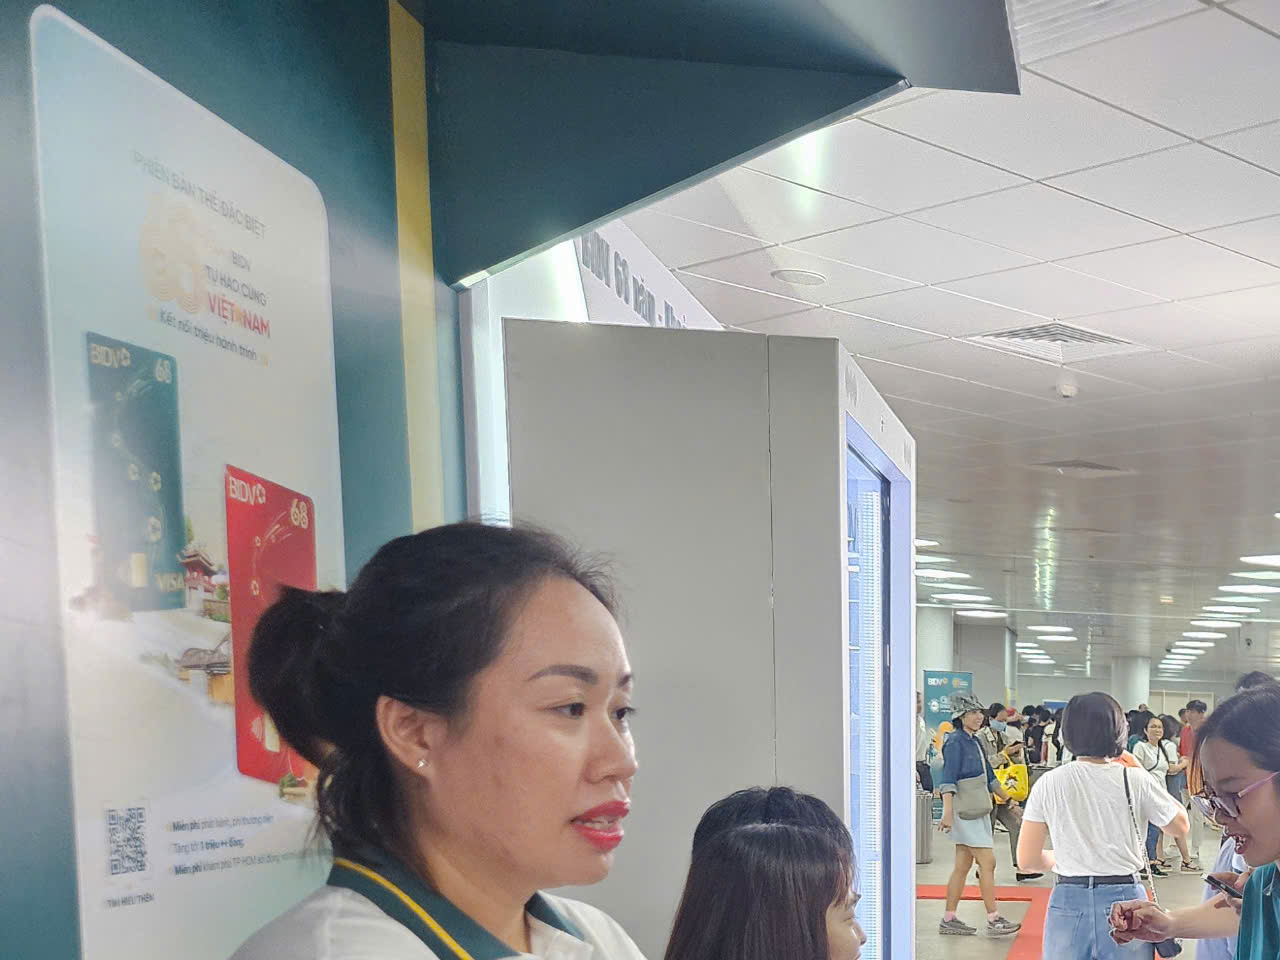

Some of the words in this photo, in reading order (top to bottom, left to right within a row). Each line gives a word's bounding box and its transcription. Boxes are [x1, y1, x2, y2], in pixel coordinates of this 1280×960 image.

[614, 250, 630, 305] 68
[242, 308, 271, 339] NAM
[90, 343, 120, 368] BIDV
[154, 358, 172, 383] 68
[228, 475, 256, 505] BIDV
[290, 498, 309, 529] 68
[155, 573, 185, 593] VISA
